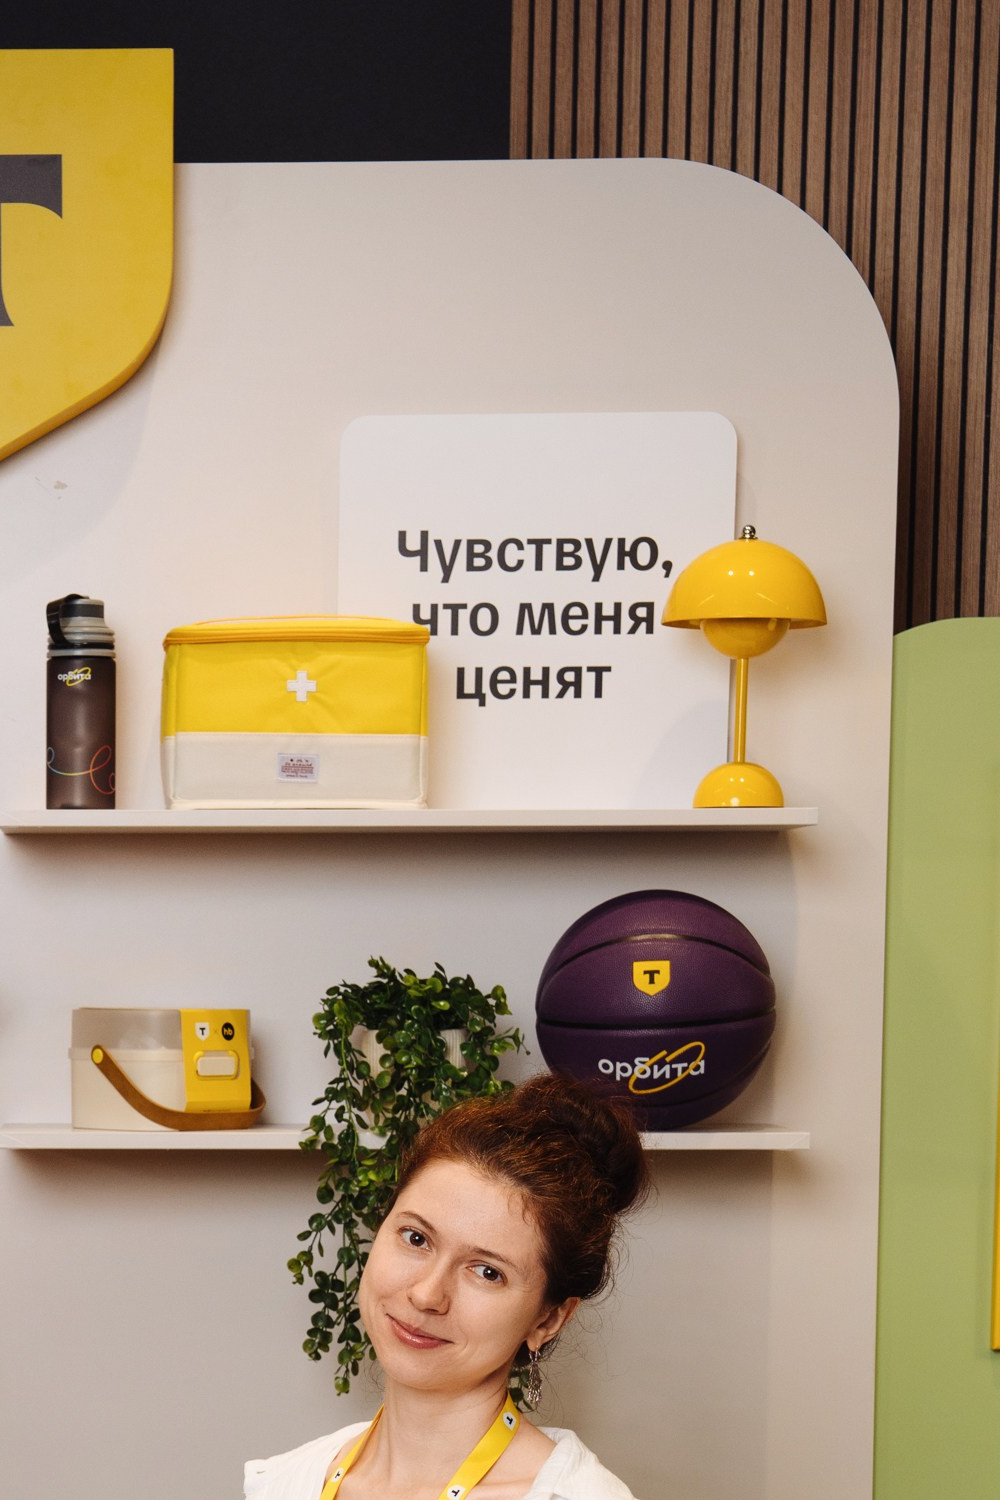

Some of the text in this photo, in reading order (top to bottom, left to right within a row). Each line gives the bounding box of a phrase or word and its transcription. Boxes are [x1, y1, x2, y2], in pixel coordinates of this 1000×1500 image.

[398, 530, 673, 583] Чувствую,
[412, 601, 655, 636] что меня
[456, 666, 612, 707] ценят
